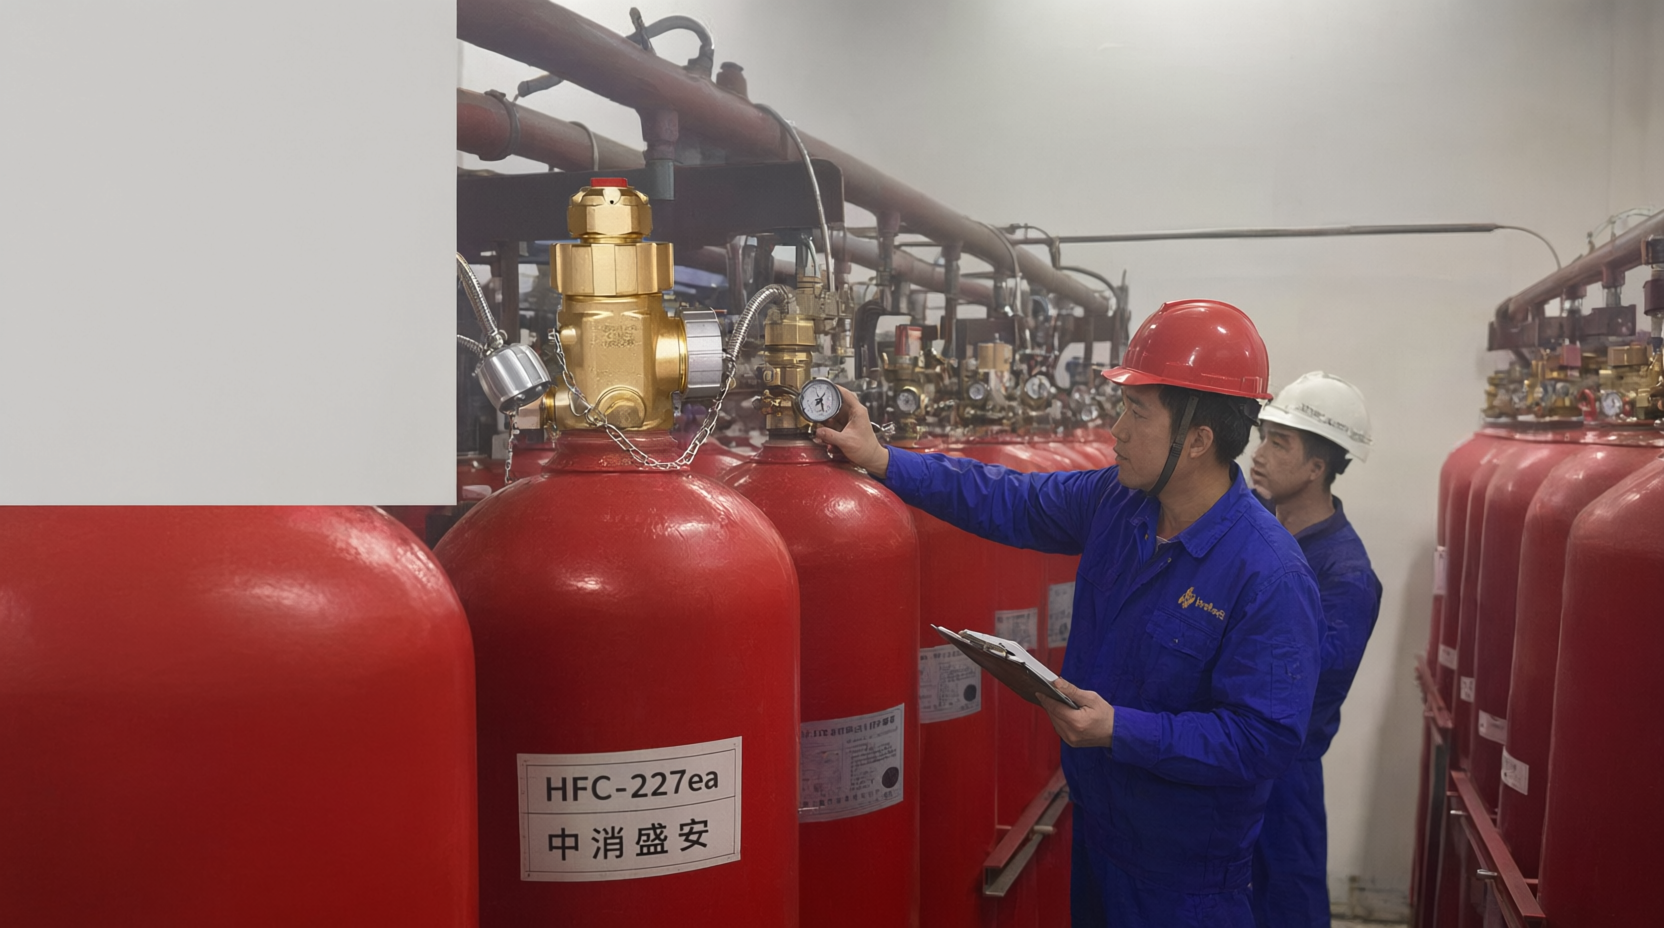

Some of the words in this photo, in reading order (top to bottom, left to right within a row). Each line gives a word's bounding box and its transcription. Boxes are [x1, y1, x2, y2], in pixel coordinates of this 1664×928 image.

[545, 768, 719, 802] HFC-227ea
[547, 818, 709, 861] 中消盛安
